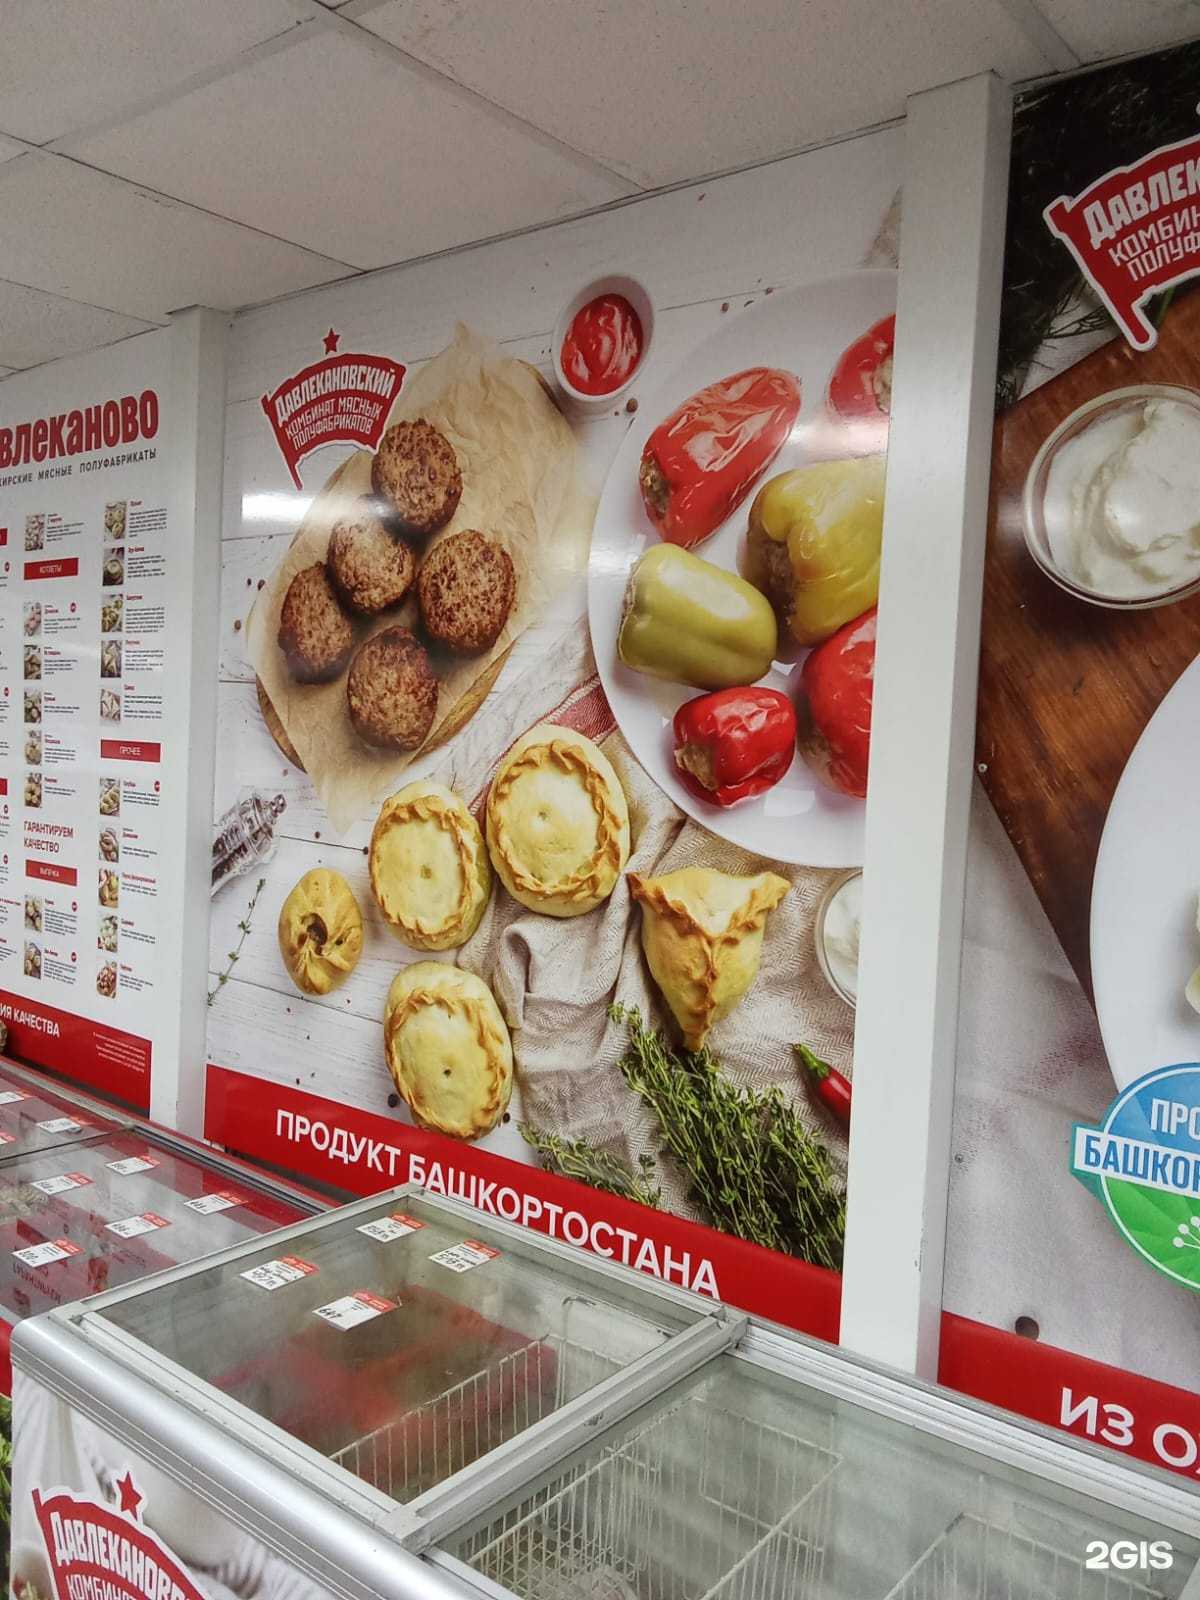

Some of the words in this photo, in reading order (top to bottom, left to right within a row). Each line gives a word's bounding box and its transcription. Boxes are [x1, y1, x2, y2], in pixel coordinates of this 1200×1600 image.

[1083, 157, 1200, 250] ДАВЛЕК
[1126, 231, 1200, 281] ПОЛУФ
[274, 364, 396, 428] ДАВЛЕКАНОВСКИЙ
[285, 398, 336, 440] КОМБИНАТ
[338, 397, 383, 420] МЯСНЫХ
[292, 414, 375, 450] ПОЛУФАБРИКАТОВ
[37, 464, 73, 481] МЯСНЫЕ
[79, 448, 157, 473] ПОЛУФАБРИКАТЫ
[23, 837, 60, 853] КАЧЕСТВО
[24, 820, 74, 838] ГАРАНТИРУЕМ
[13, 1008, 60, 1038] КАЧЕСТВА
[1150, 1098, 1200, 1141] ПРО
[276, 1109, 400, 1177] ПРОДУКТ
[408, 1153, 721, 1301] БАШКОРТОСТАНА
[1060, 1387, 1135, 1447] ИЗ
[1152, 1423, 1200, 1475] О
